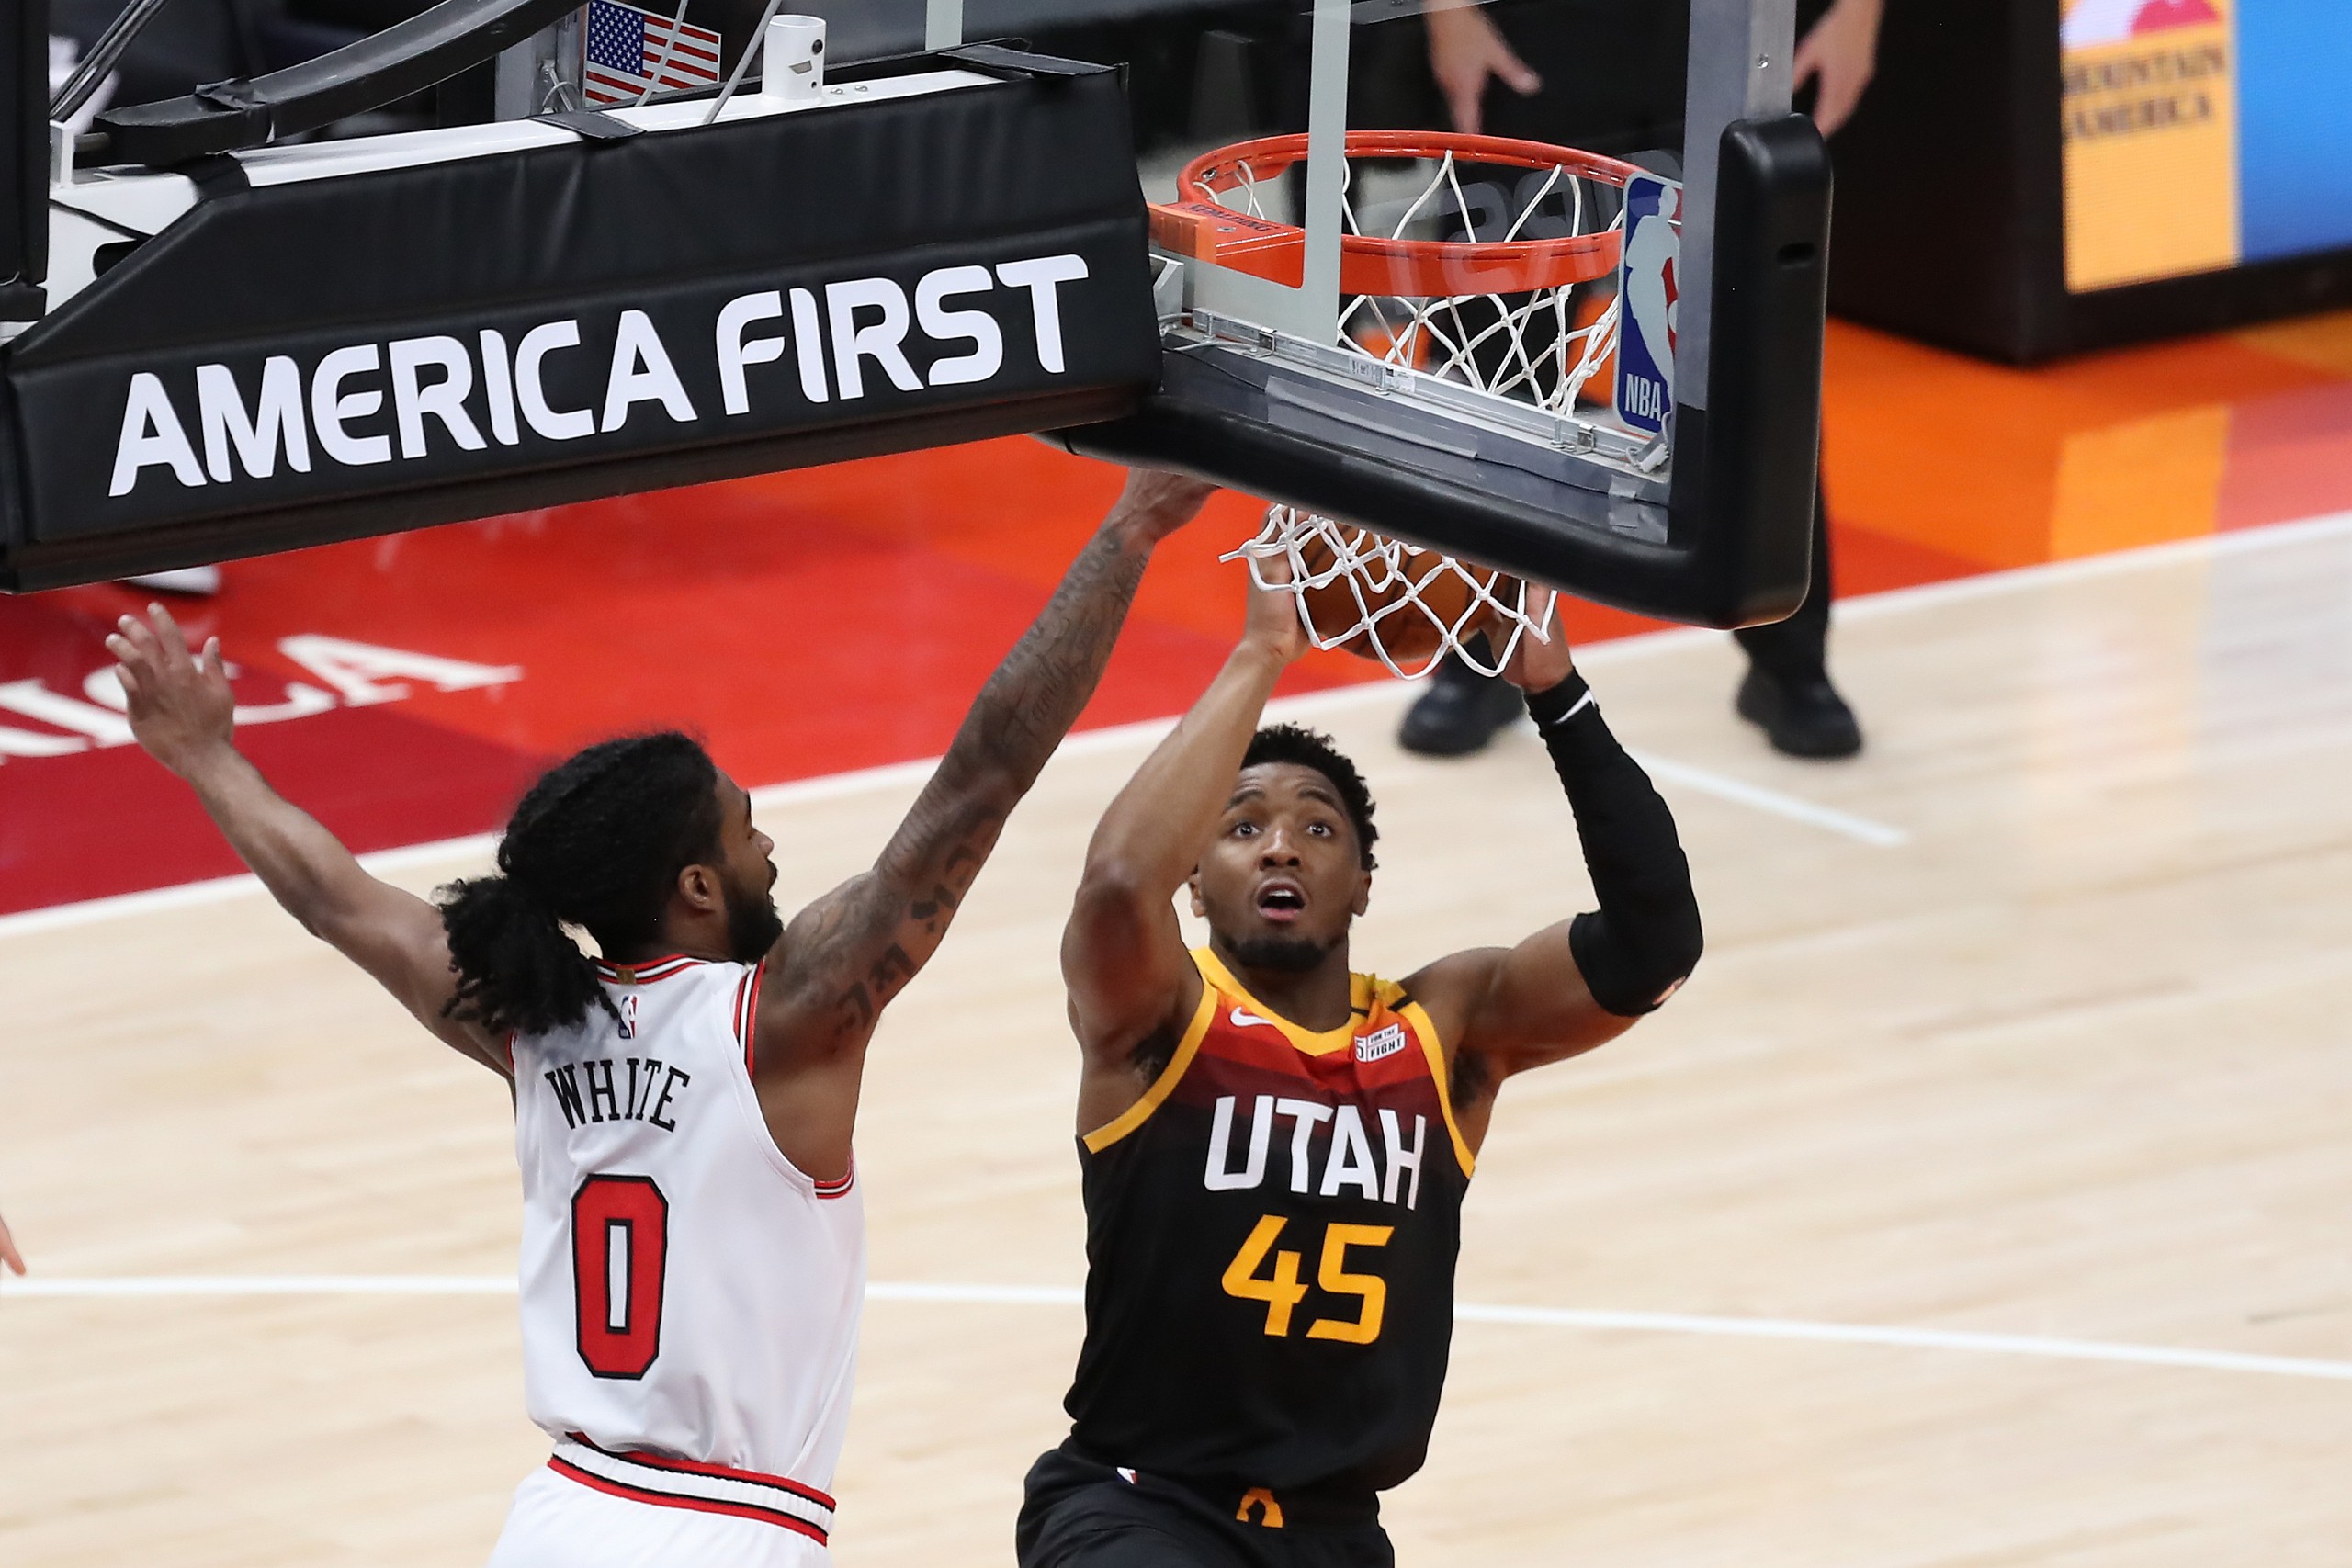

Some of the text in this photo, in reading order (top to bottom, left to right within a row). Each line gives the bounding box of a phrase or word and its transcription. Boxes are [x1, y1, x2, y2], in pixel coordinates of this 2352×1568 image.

[2065, 93, 2211, 140] AMERICA
[108, 254, 1090, 497] AMERICA FIRST
[1625, 373, 1661, 422] NBA
[543, 1057, 691, 1133] WHITE
[1370, 1036, 1402, 1058] FIGHT
[1204, 1095, 1426, 1211] UTAH
[571, 1172, 669, 1381] 0
[1221, 1214, 1395, 1344] 45
